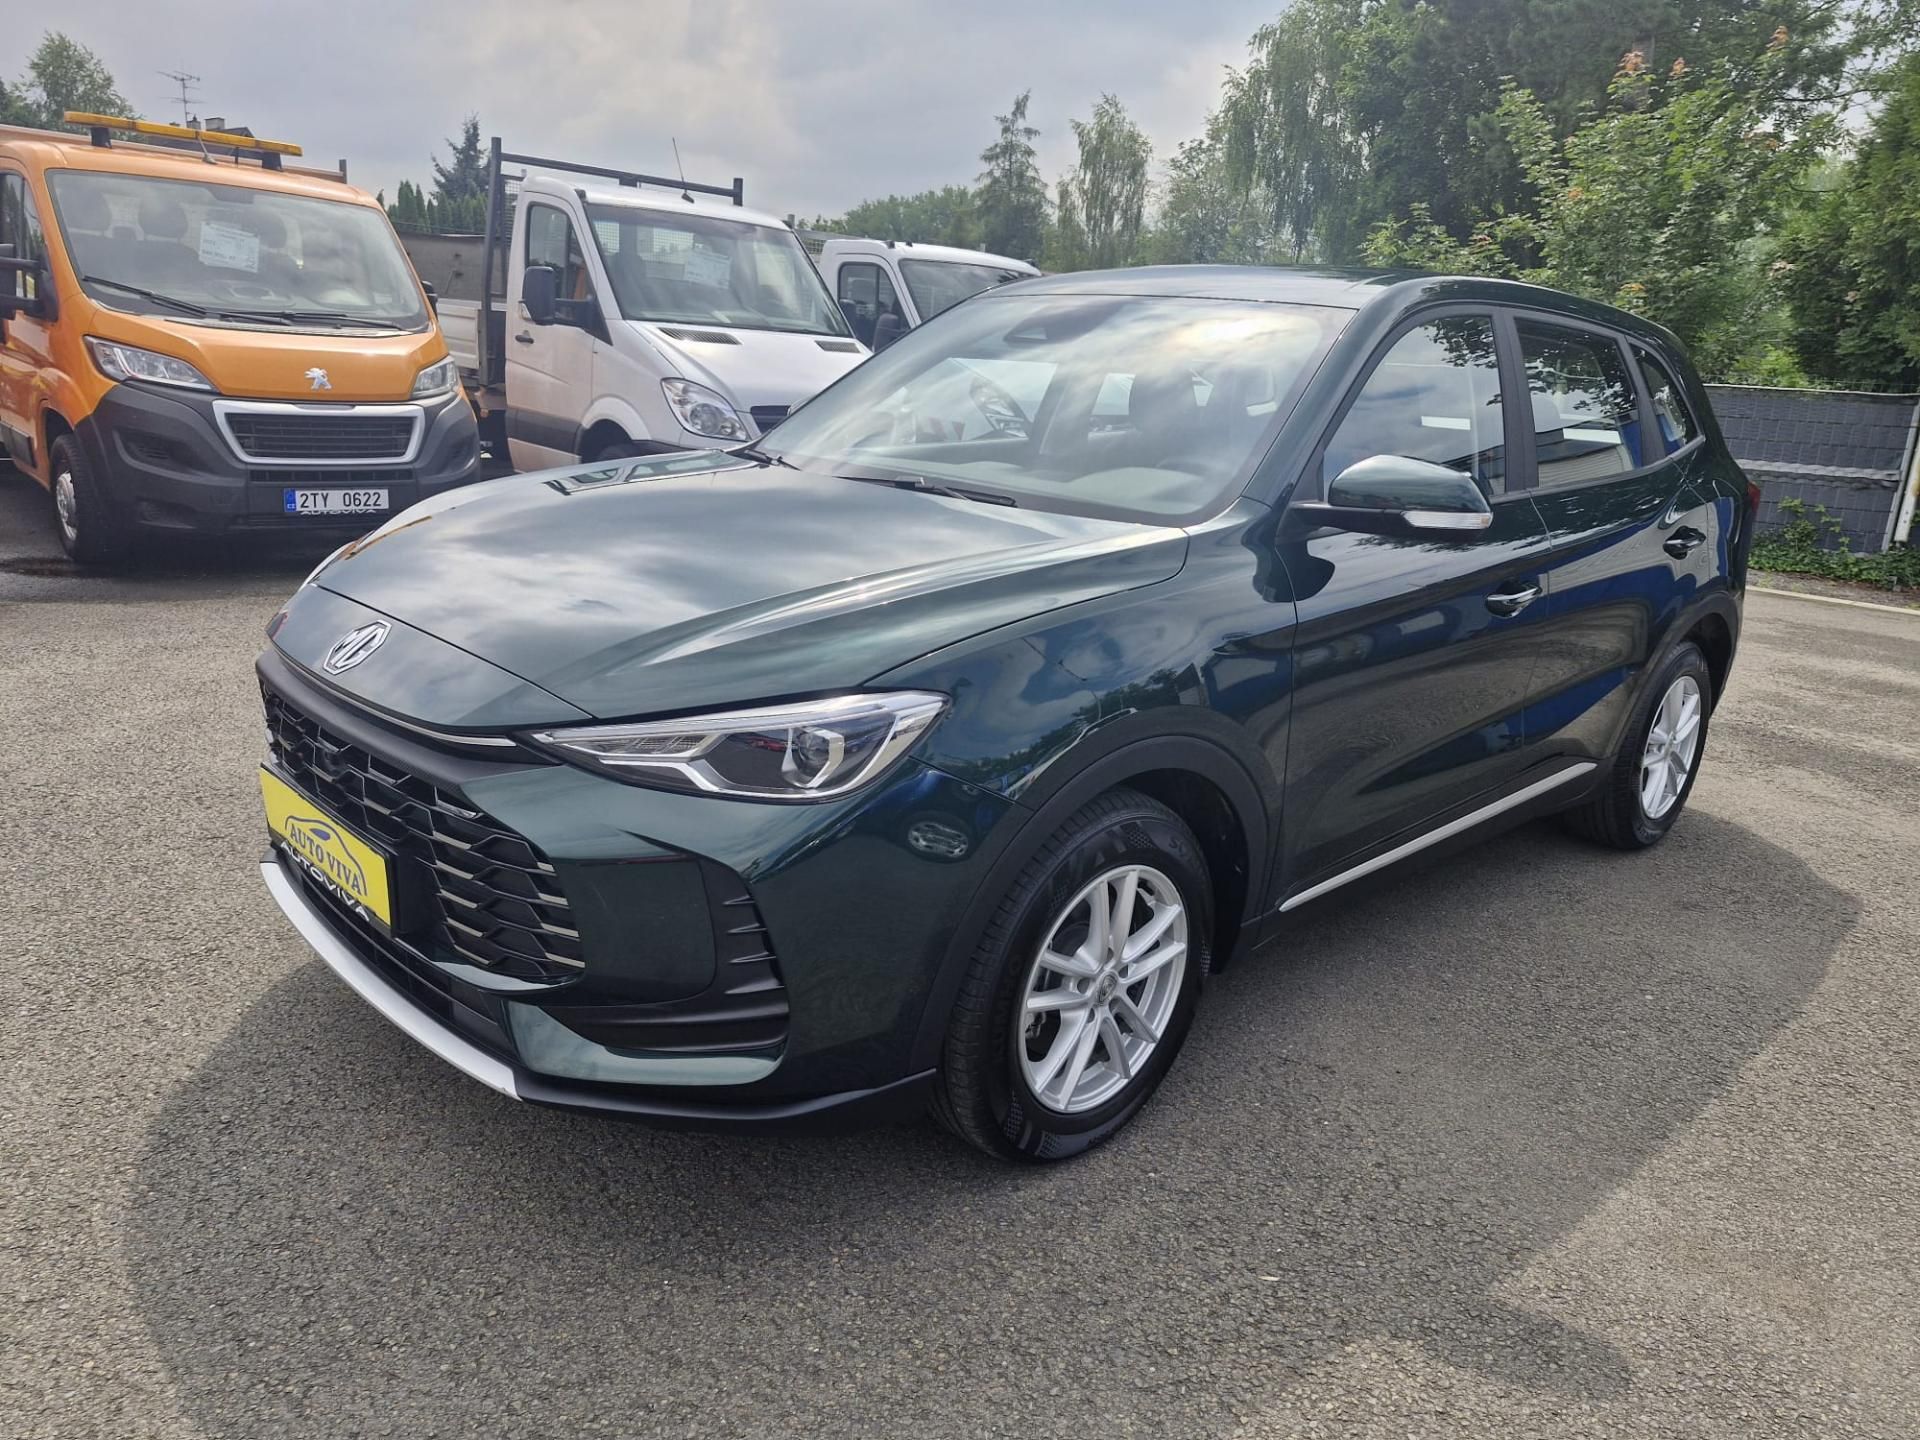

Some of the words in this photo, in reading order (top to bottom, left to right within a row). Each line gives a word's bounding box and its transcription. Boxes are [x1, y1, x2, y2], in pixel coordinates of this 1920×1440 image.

[300, 493, 329, 508] 2TY
[343, 492, 381, 507] 0622
[290, 823, 325, 864] AUTO
[326, 851, 363, 896] VIVA
